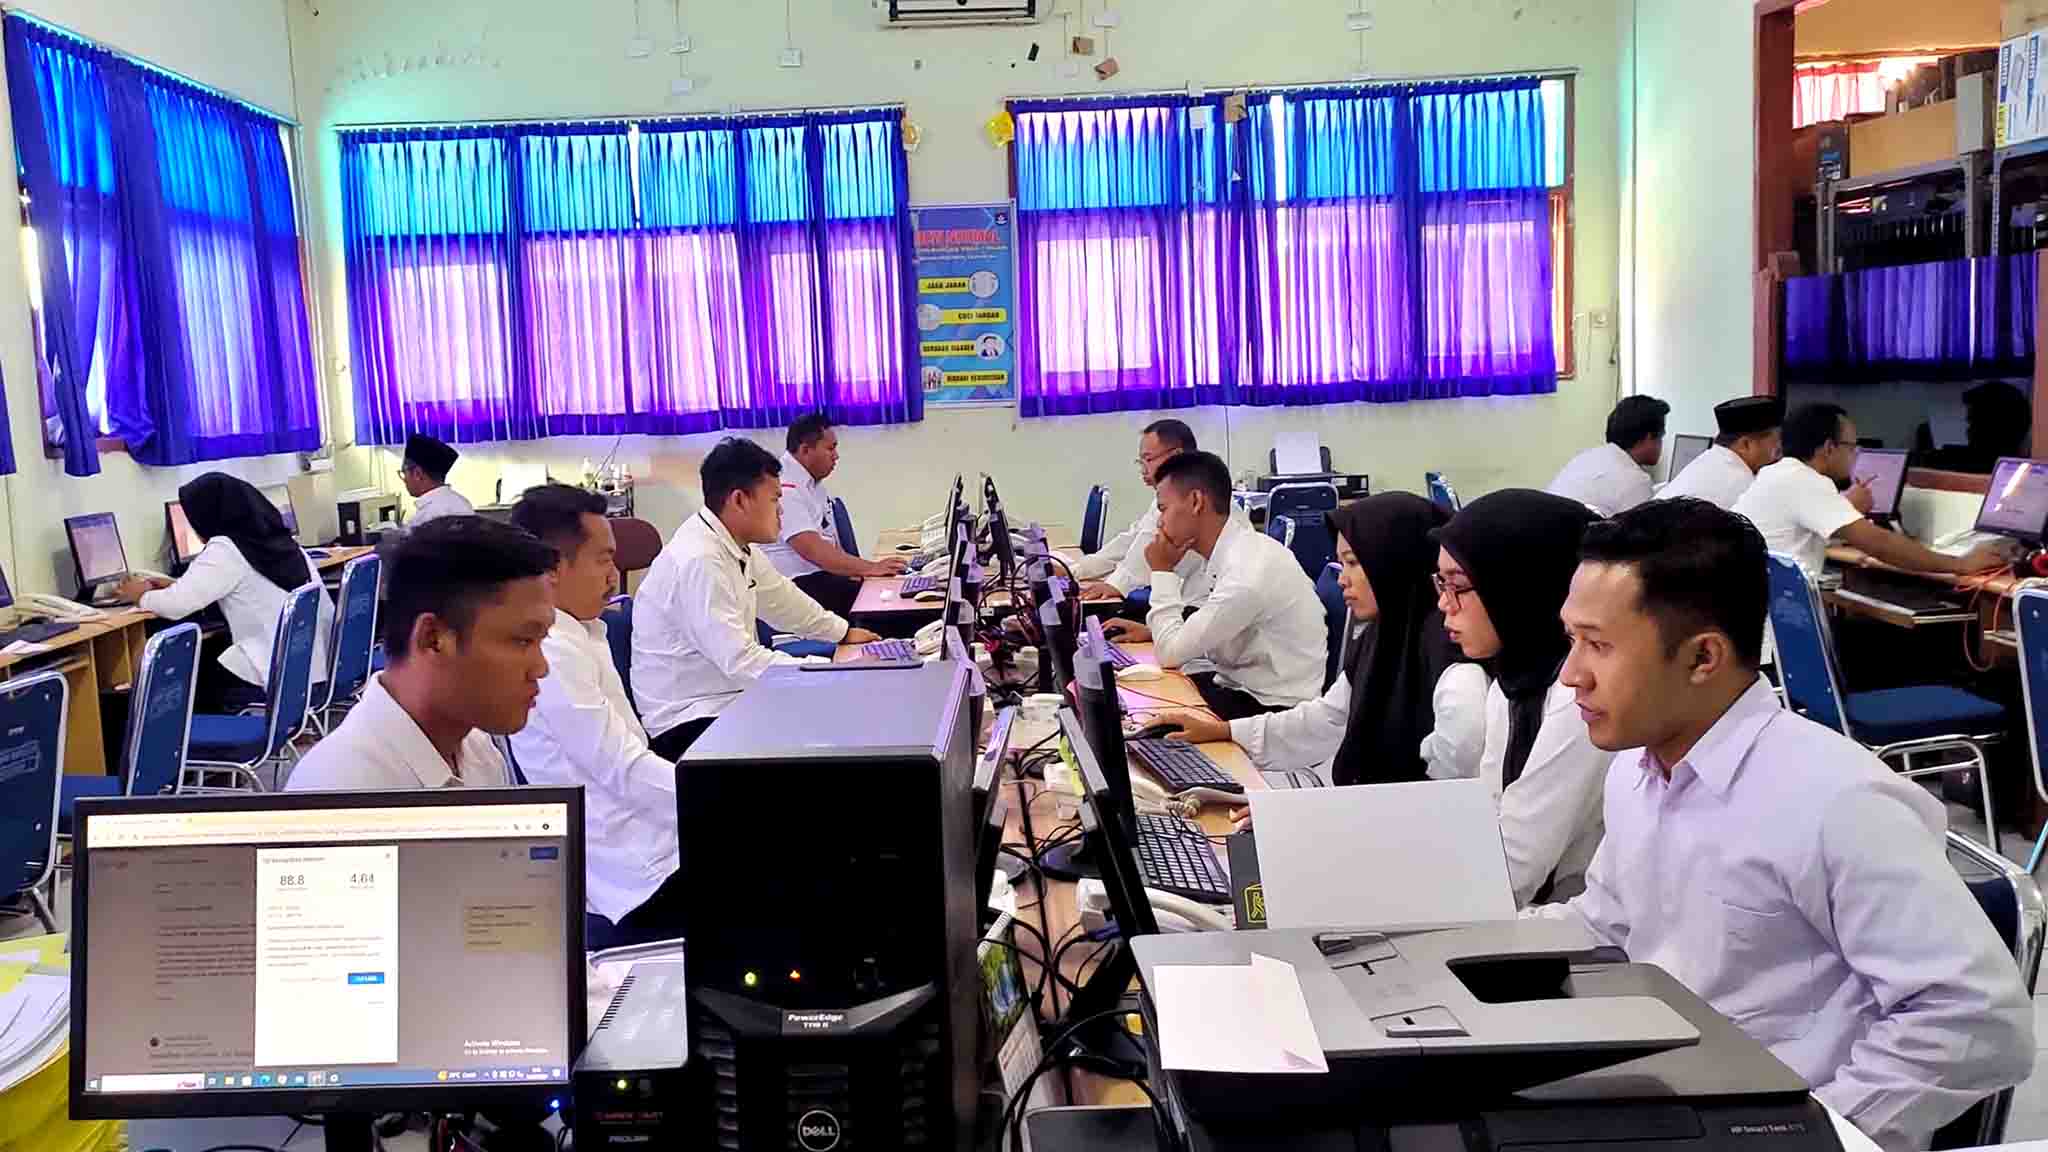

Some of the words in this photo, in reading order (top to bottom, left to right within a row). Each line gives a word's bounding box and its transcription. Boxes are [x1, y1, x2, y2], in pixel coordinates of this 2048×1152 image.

[279, 874, 305, 886] 88.8
[788, 1013, 844, 1023] PowerEdge
[802, 1125, 837, 1137] DELL
